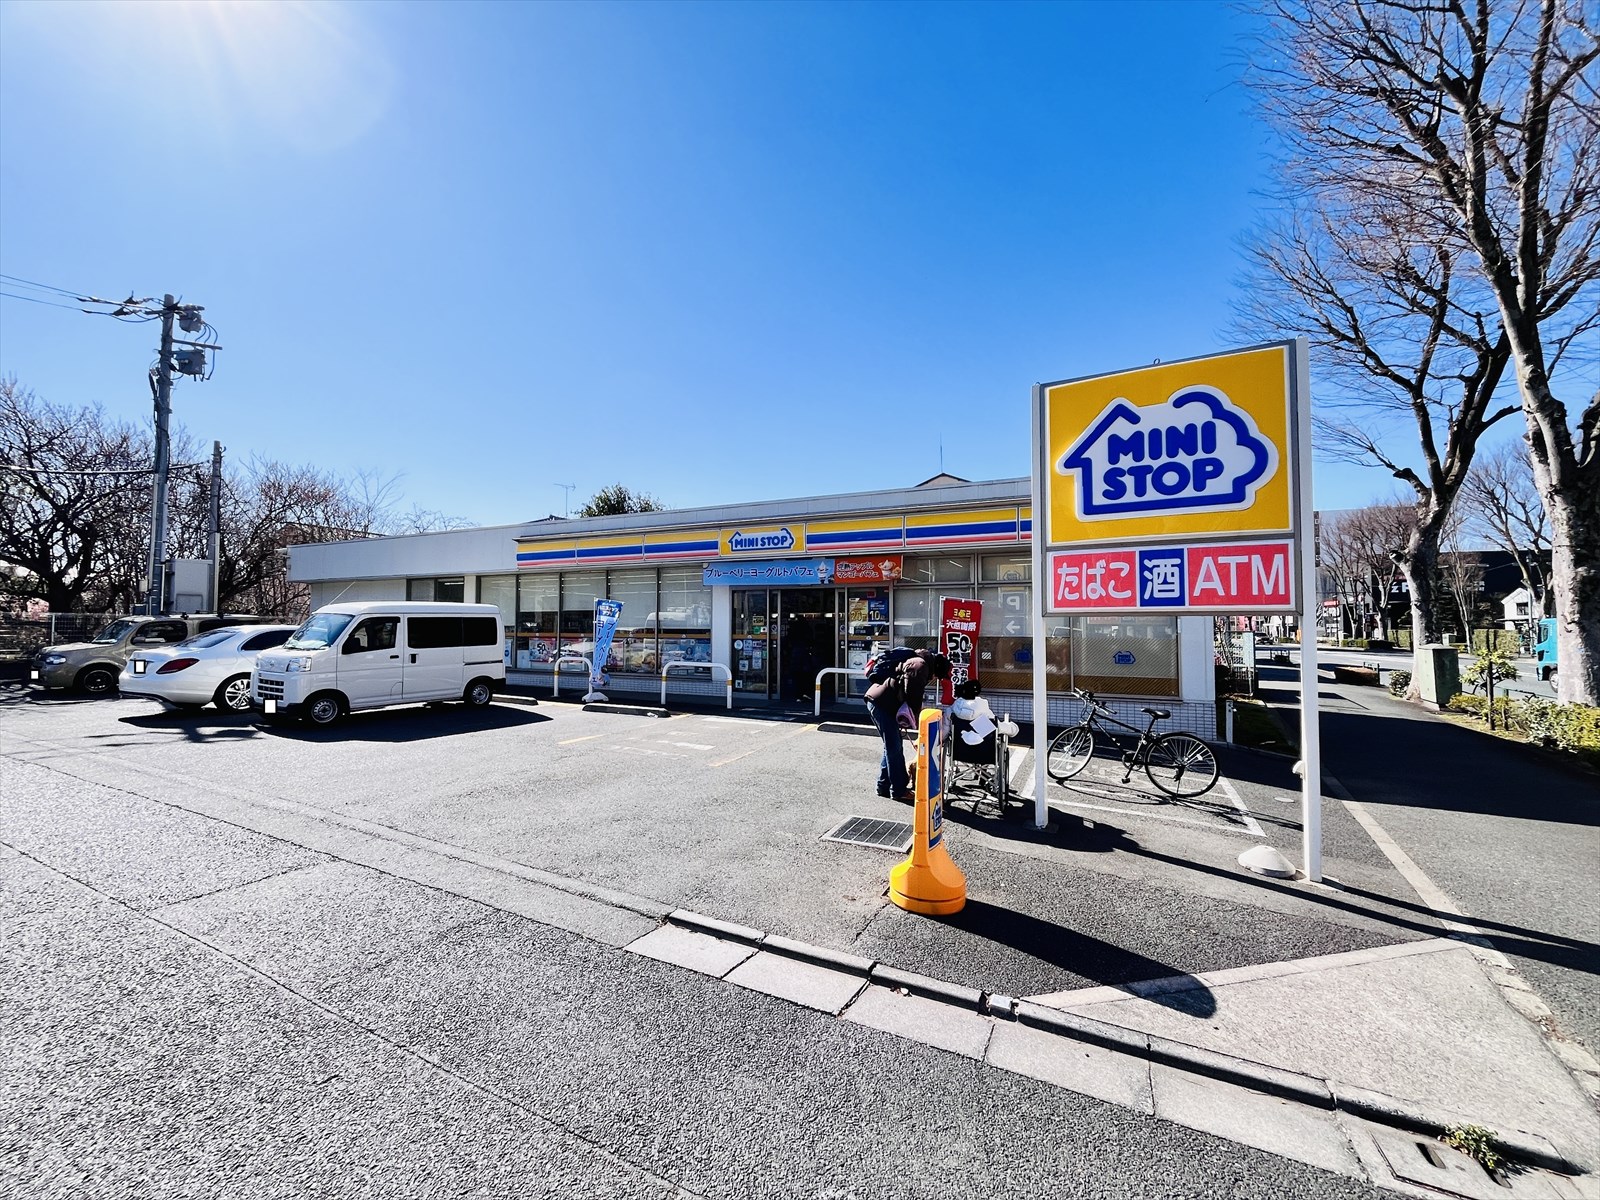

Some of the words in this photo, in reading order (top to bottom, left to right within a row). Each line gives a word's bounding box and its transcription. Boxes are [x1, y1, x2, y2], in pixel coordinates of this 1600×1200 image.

[1107, 420, 1217, 465] MINI
[1102, 457, 1225, 501] STOP
[734, 537, 758, 548] MINI
[760, 535, 788, 547] STOP
[705, 566, 814, 579] ブルーベリーヨーグルトパフェ
[1056, 558, 1132, 601] たばこ
[1143, 557, 1181, 600] 酒
[1193, 553, 1286, 597] ATM
